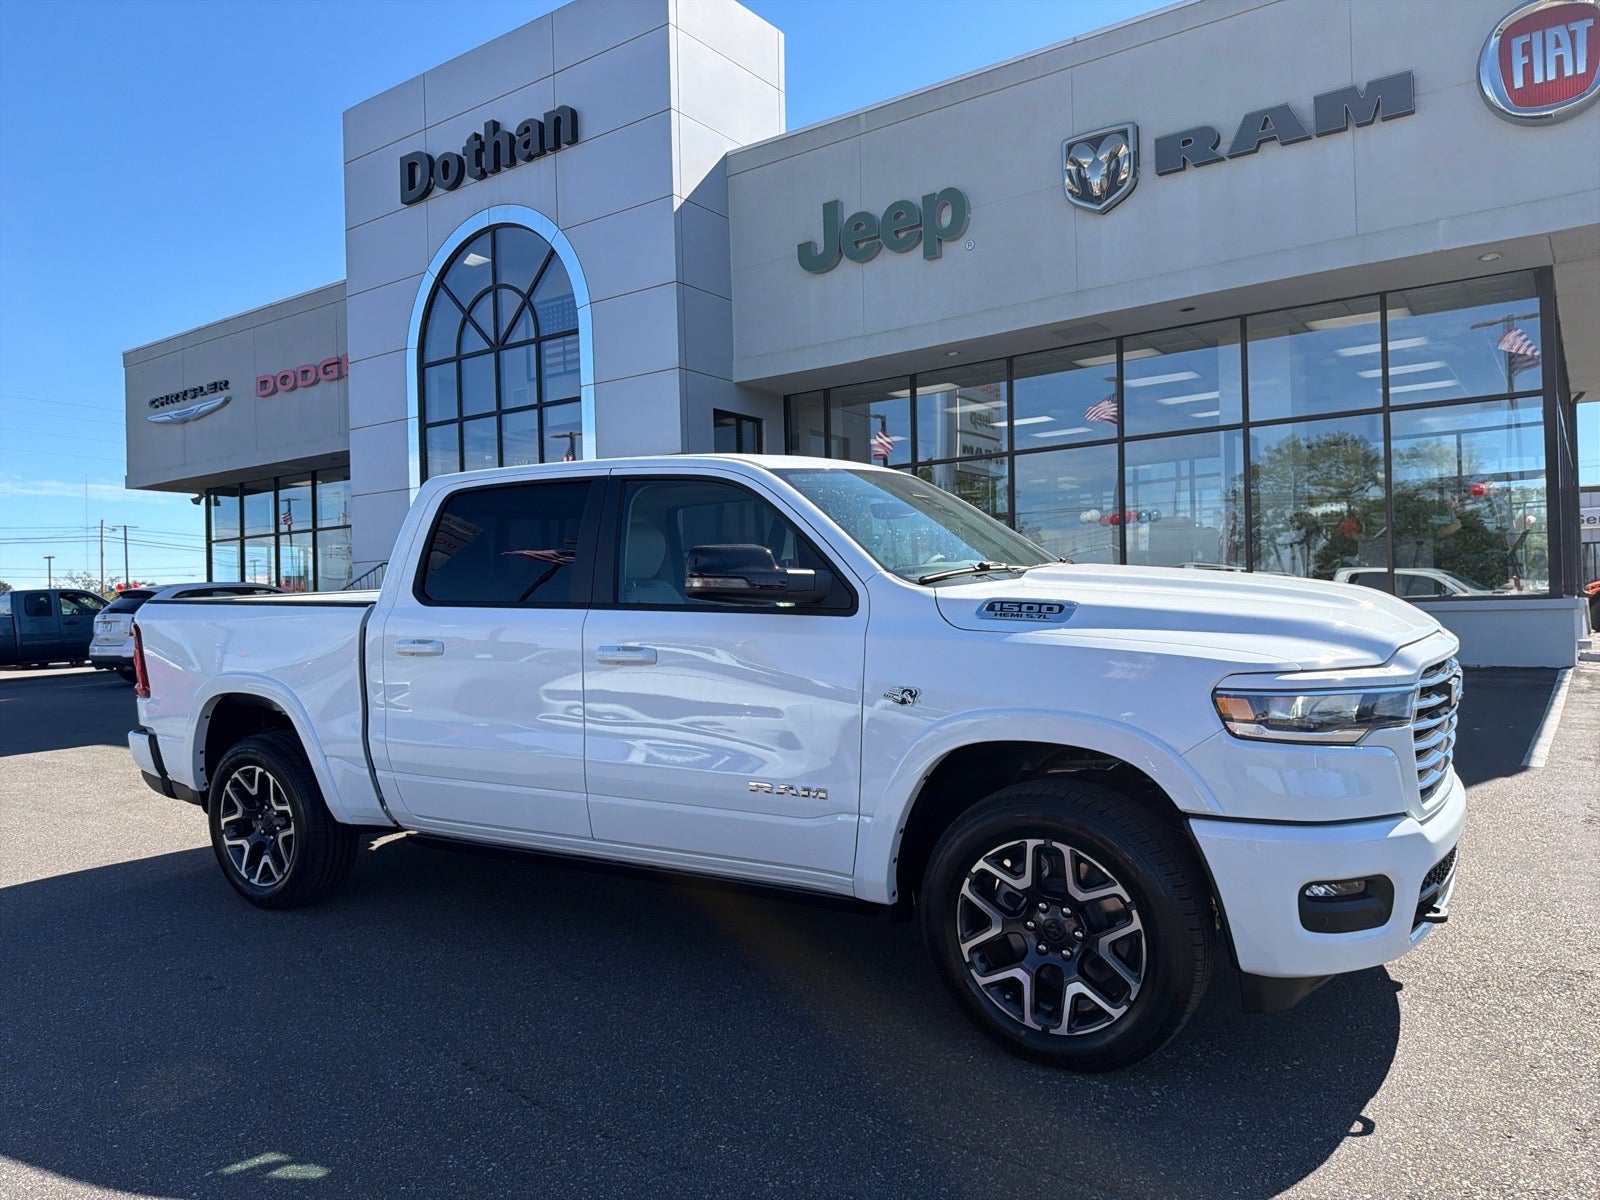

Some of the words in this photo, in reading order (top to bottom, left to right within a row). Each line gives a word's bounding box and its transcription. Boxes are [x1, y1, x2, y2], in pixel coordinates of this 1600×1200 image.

[1511, 18, 1594, 90] FIAT
[400, 105, 579, 205] Dothan
[1154, 69, 1415, 176] RAM
[797, 187, 971, 275] Jeep
[149, 380, 230, 409] CHRYSLER
[994, 602, 1060, 614] 1500
[749, 781, 828, 800] RAM
